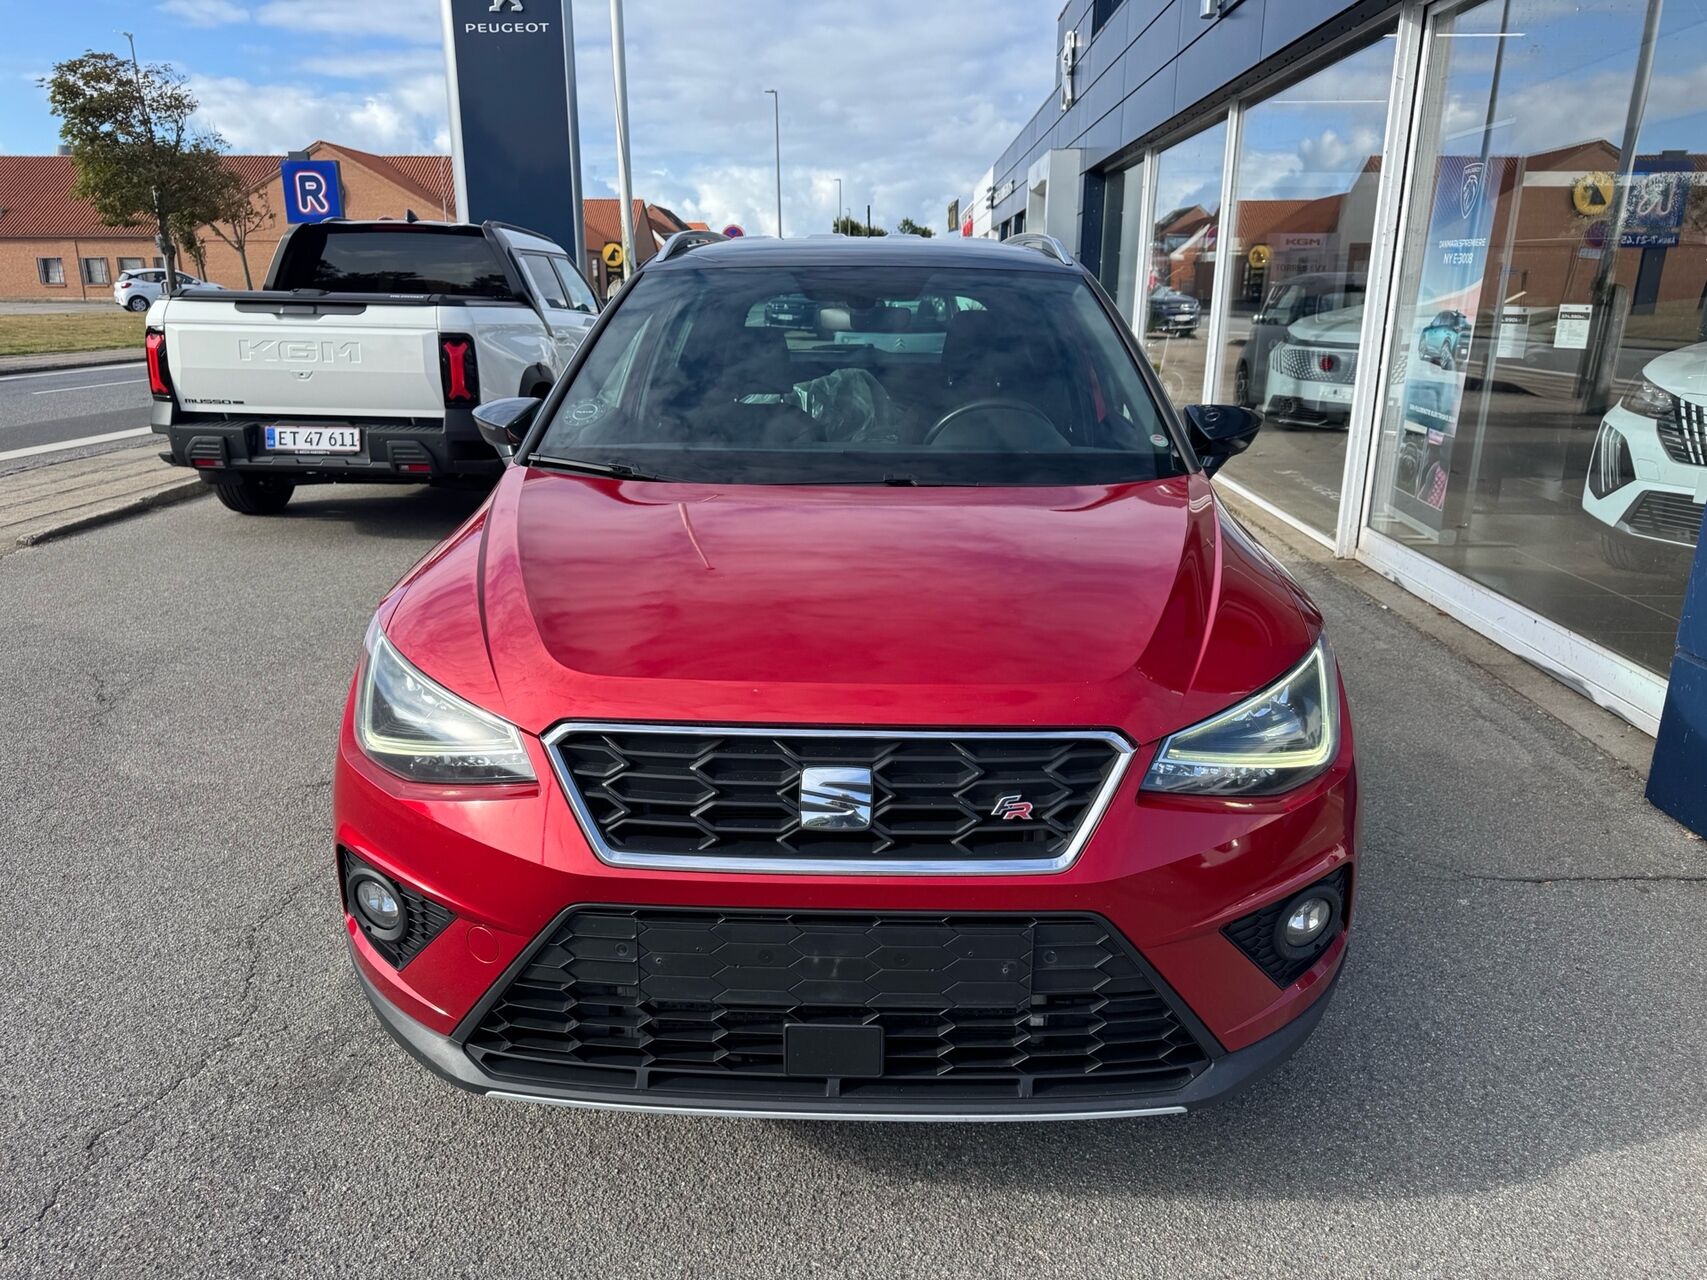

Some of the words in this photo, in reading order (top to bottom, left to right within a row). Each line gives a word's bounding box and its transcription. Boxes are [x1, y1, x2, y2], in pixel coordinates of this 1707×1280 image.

[465, 22, 549, 33] PEUGEOT
[295, 171, 328, 213] R
[1285, 238, 1321, 246] KGM
[1443, 252, 1452, 264] NY
[238, 339, 362, 363] KGM
[278, 431, 299, 446] ET
[304, 431, 323, 446] 47
[328, 432, 357, 447] 611
[990, 794, 1033, 820] FR
